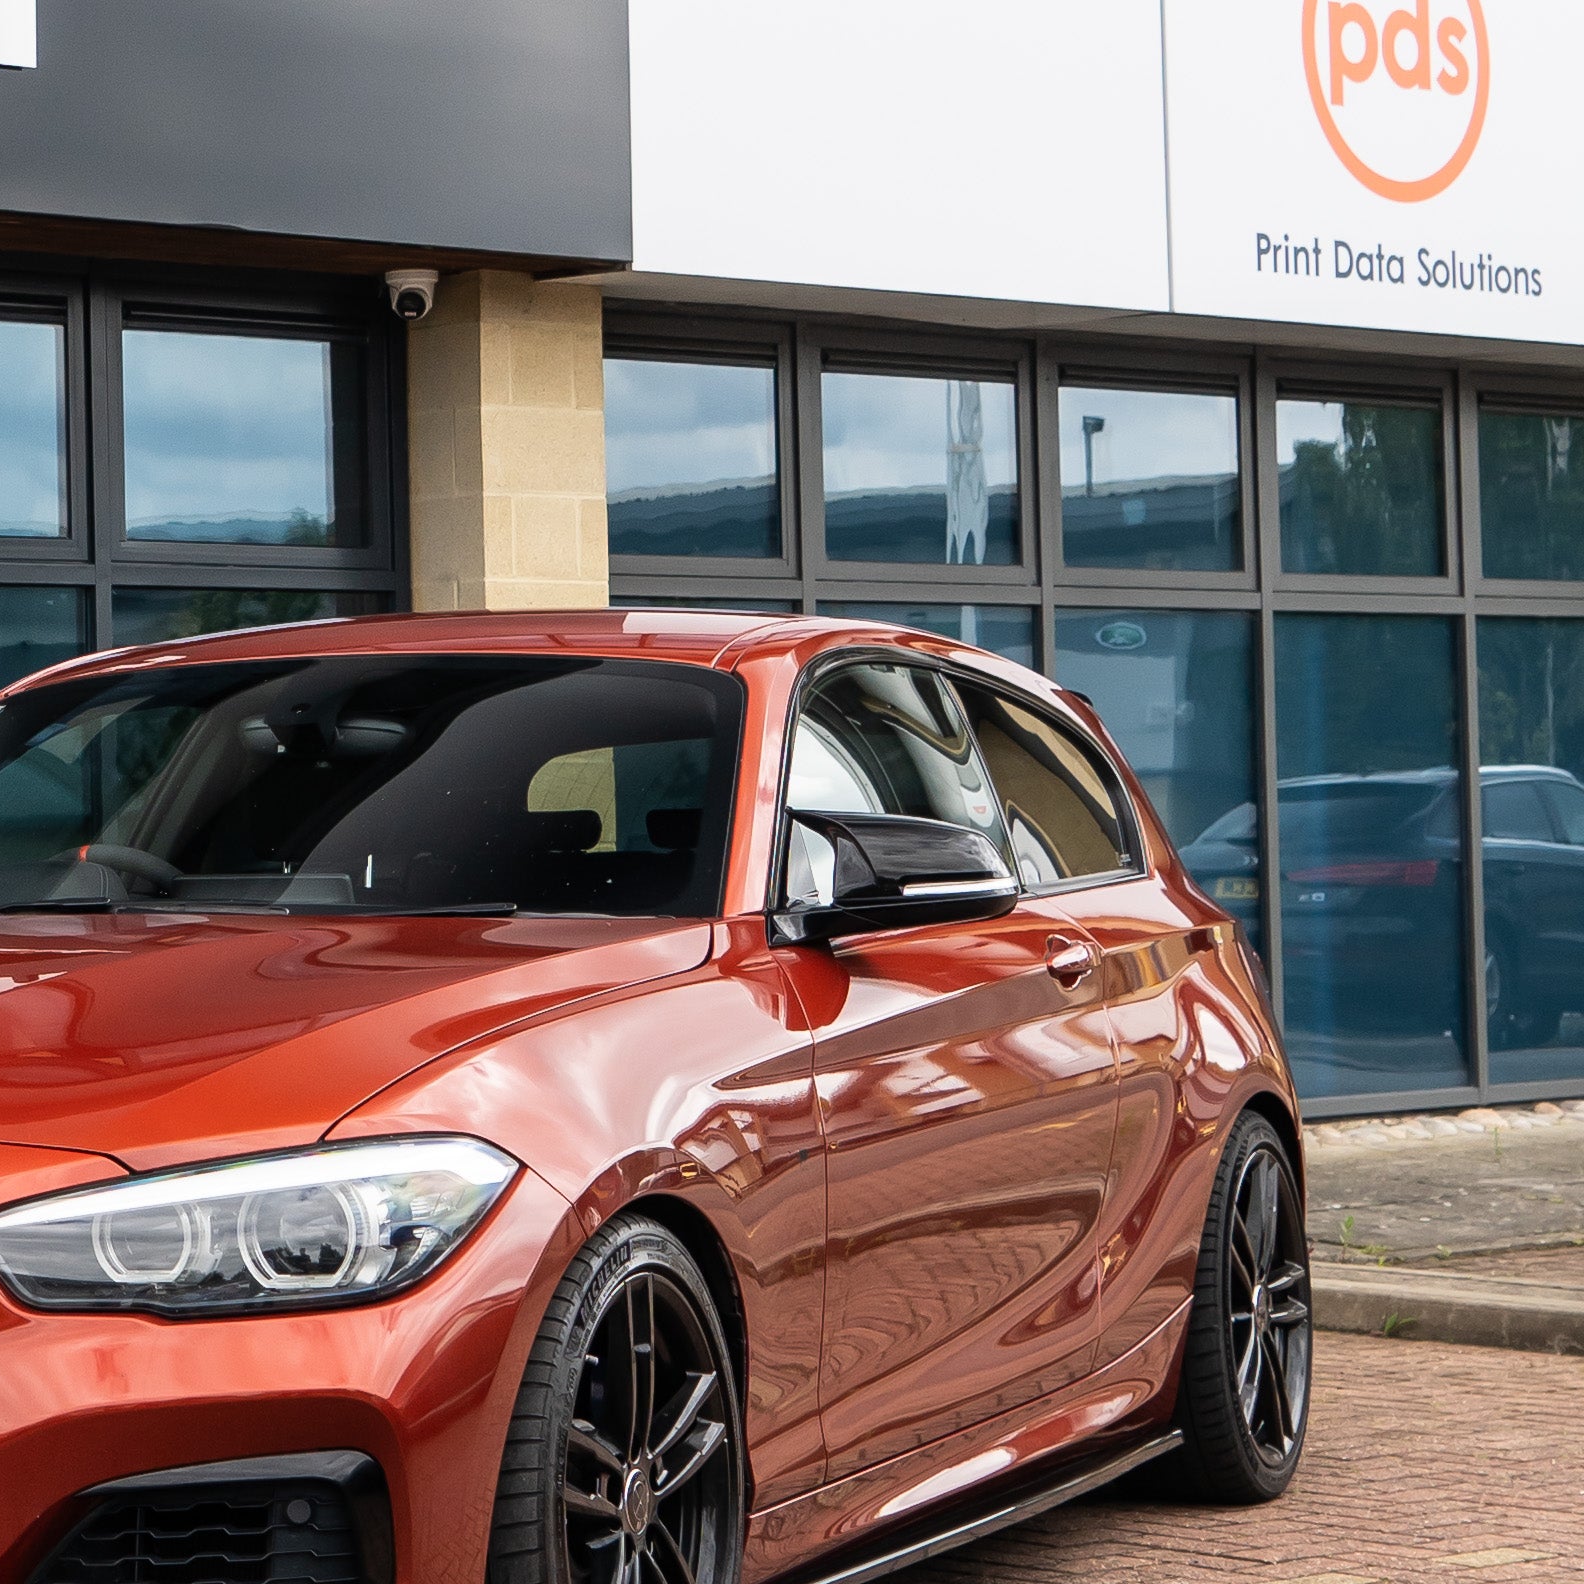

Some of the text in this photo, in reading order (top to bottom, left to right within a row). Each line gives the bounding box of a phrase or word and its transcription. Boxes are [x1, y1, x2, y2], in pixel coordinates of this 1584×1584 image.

[1256, 232, 1543, 297] Print Data Solutions
